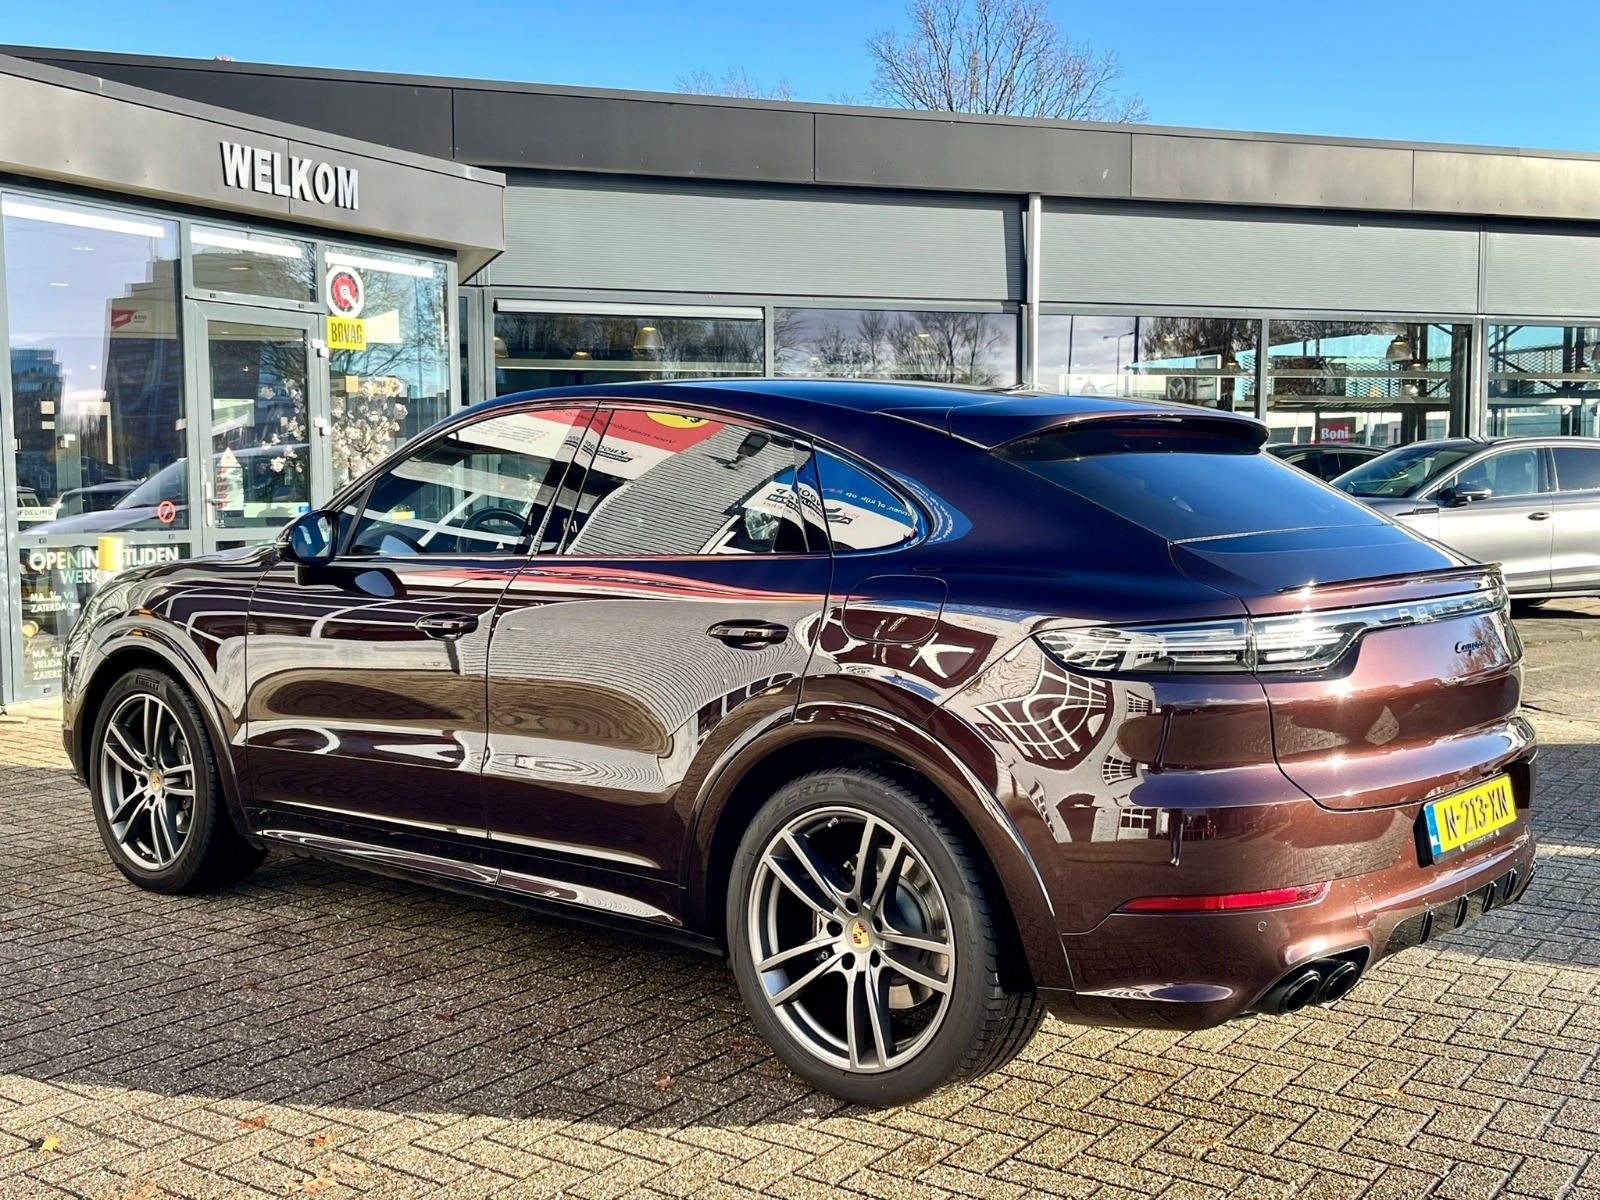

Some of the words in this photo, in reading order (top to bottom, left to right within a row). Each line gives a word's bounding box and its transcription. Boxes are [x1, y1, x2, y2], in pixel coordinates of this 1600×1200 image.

[220, 140, 359, 210] WELKOM
[331, 322, 363, 345] BOVAG
[1321, 426, 1349, 440] Boni
[30, 547, 180, 571] OPENINTIJDEN
[60, 571, 99, 585] WERK
[33, 659, 62, 670] VRIJDA
[1443, 785, 1509, 841] N-213-XN
